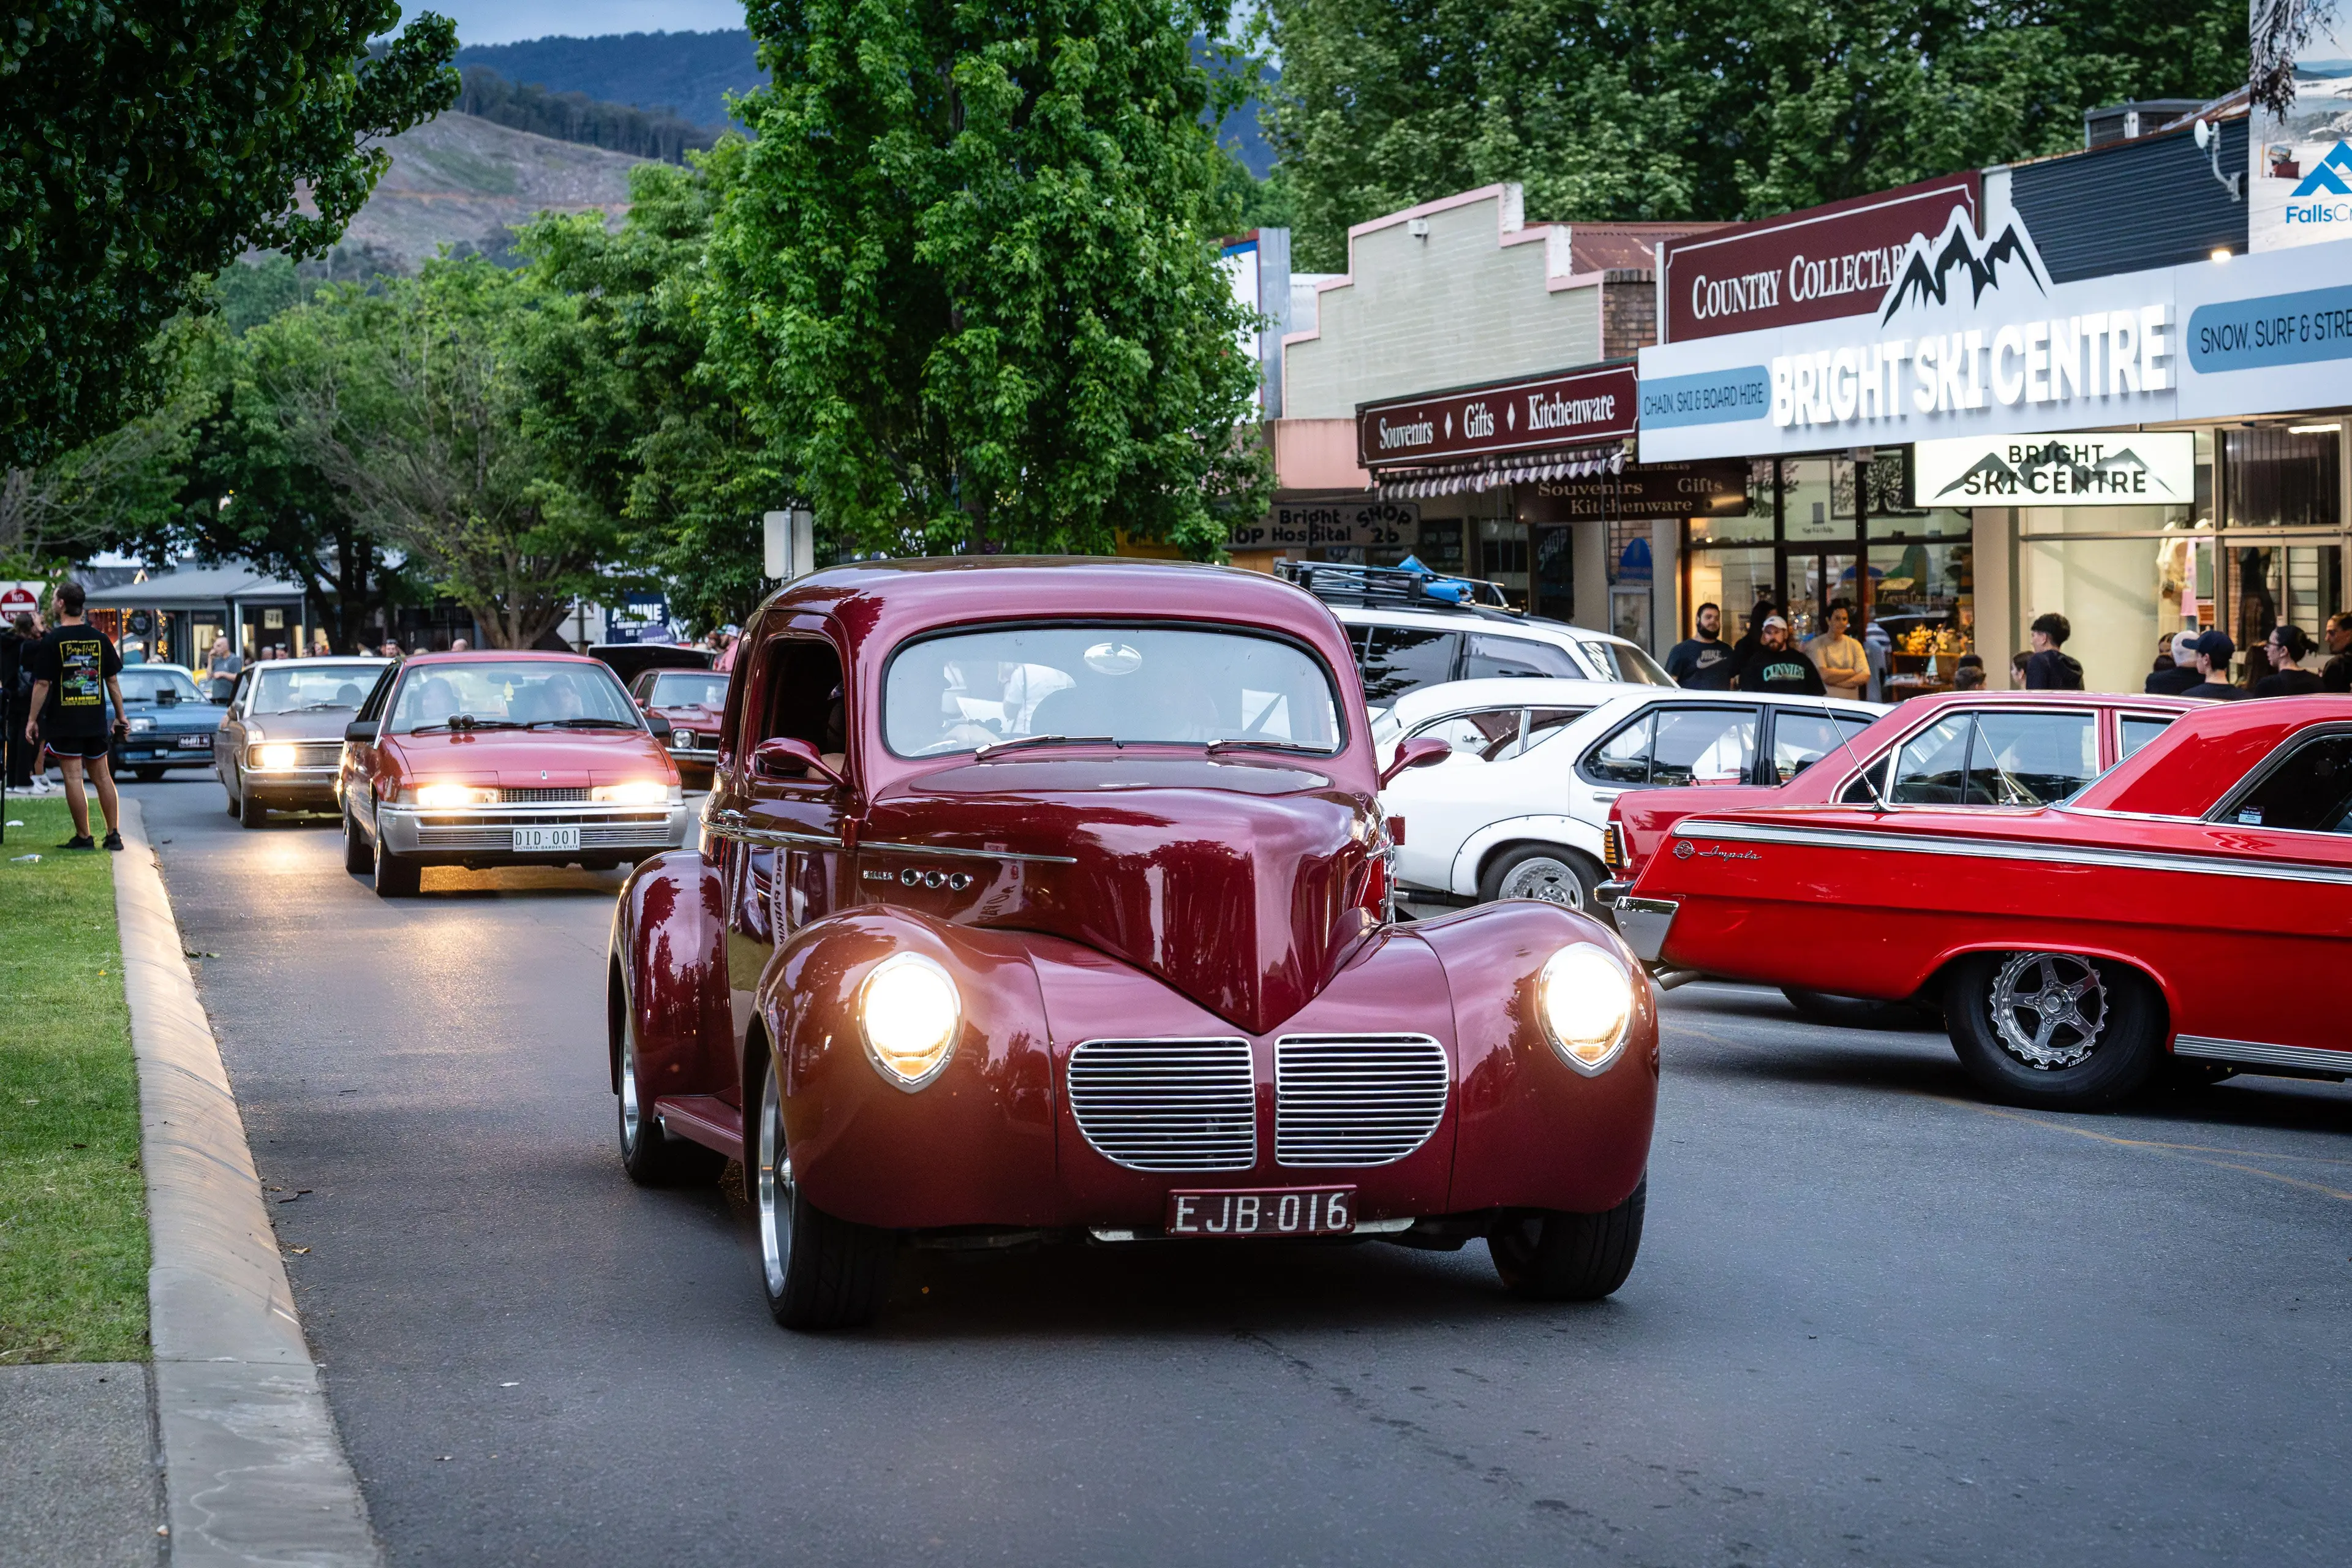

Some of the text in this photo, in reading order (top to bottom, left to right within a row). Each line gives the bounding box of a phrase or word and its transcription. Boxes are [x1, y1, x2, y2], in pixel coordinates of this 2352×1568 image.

[1692, 238, 1937, 320] COUNTRY COLLECTAB
[2200, 323, 2252, 354] SNOW,
[2255, 316, 2296, 347] SURF
[2300, 314, 2310, 343] &
[1772, 304, 2169, 427] BRIGHT SKI CENTRE
[1677, 391, 1694, 412] SKI
[1695, 390, 1701, 410] &
[1703, 385, 1738, 409] BOARD
[1740, 382, 1764, 405] HIRE
[1379, 391, 1616, 450] Souvenirs Gifts Kitchenware
[2008, 443, 2105, 464] BRIGHT
[1538, 477, 1724, 497] Souvenirs Gifts
[1964, 469, 2147, 496] SKI CENTRE
[1280, 508, 1341, 530] Bright
[1356, 505, 1412, 527] SHOP
[1272, 526, 1351, 546] Hospital
[12, 592, 24, 602] NO
[611, 603, 663, 622] APINE
[1698, 845, 1762, 862] Impala
[2067, 1050, 2092, 1068] STREET
